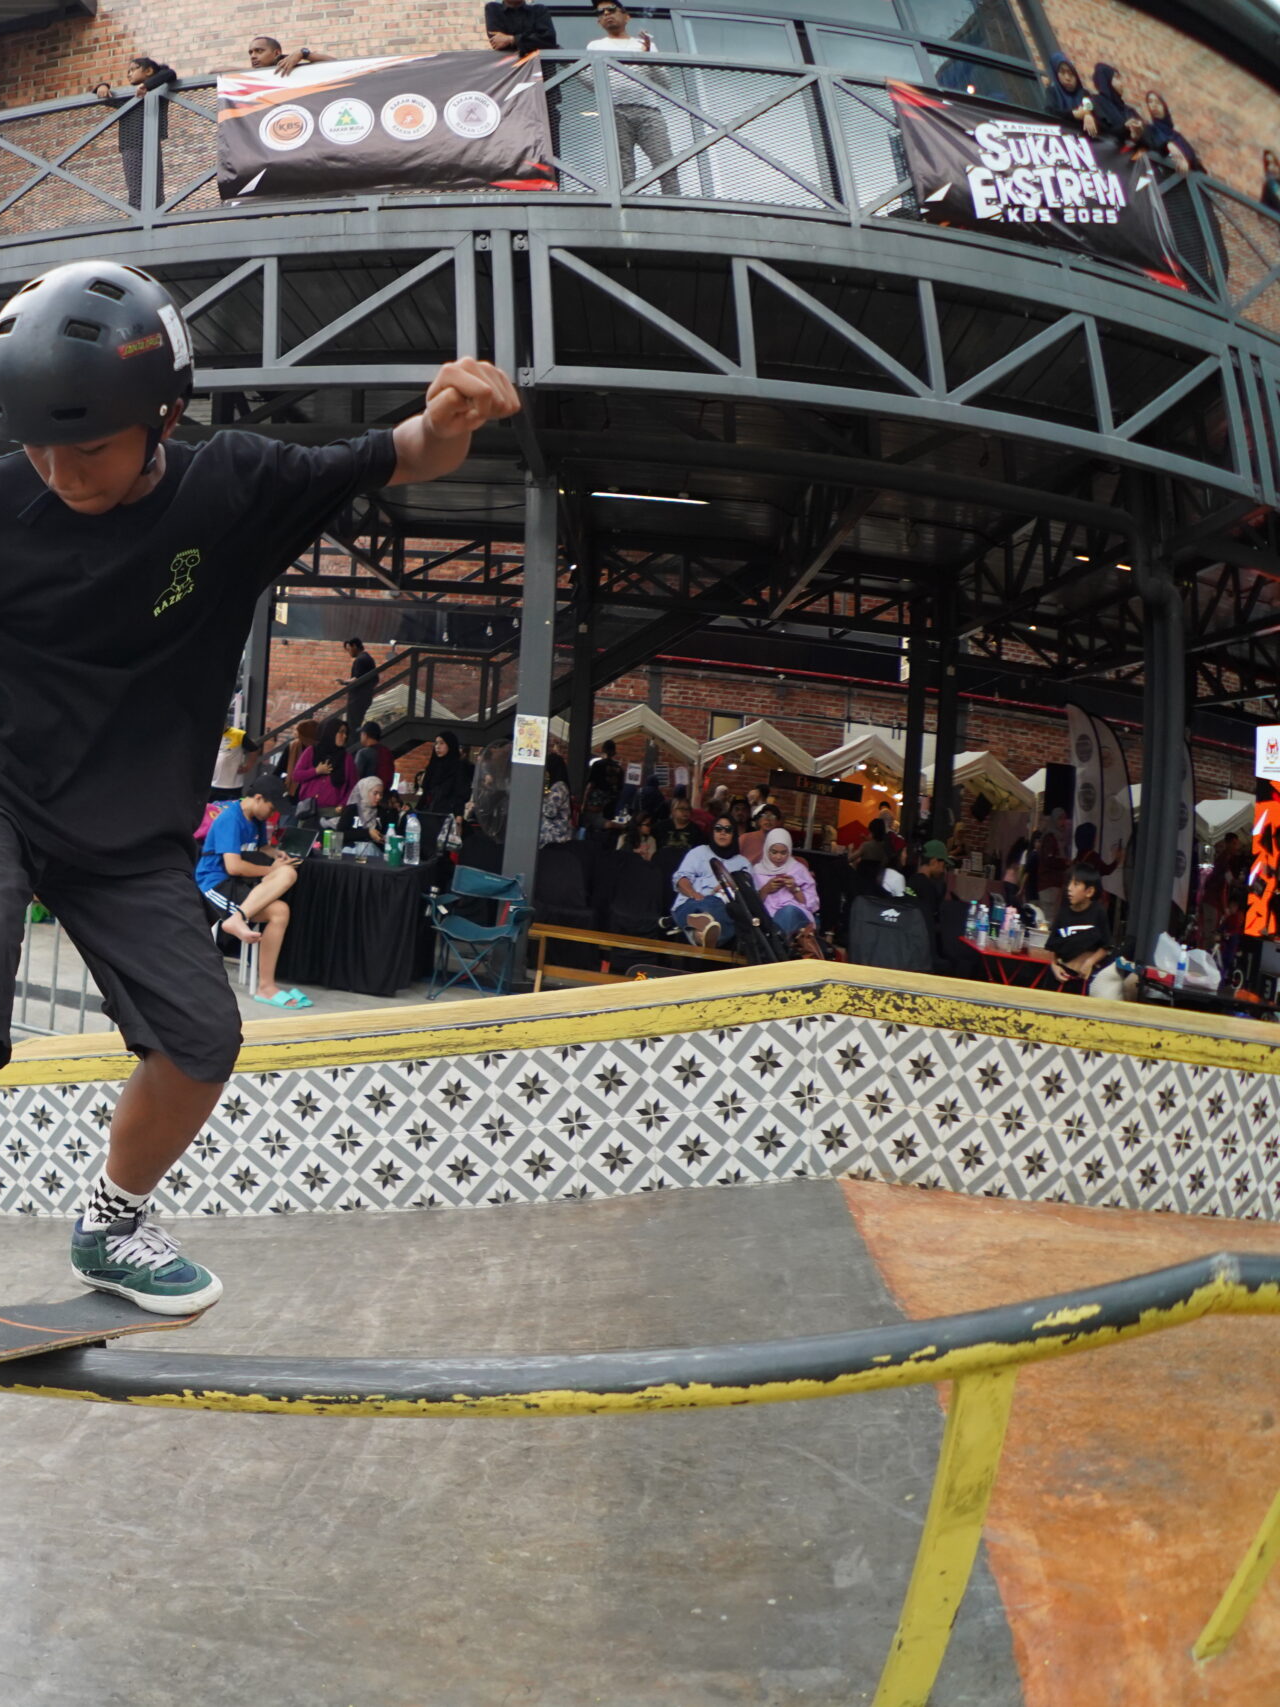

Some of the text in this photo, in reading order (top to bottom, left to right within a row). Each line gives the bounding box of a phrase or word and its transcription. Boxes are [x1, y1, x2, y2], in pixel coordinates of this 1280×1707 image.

[278, 121, 301, 132] KBS
[974, 122, 1098, 172] SUKAN
[965, 165, 1126, 221] EKSTREM
[1007, 207, 1119, 224] KBS 2025
